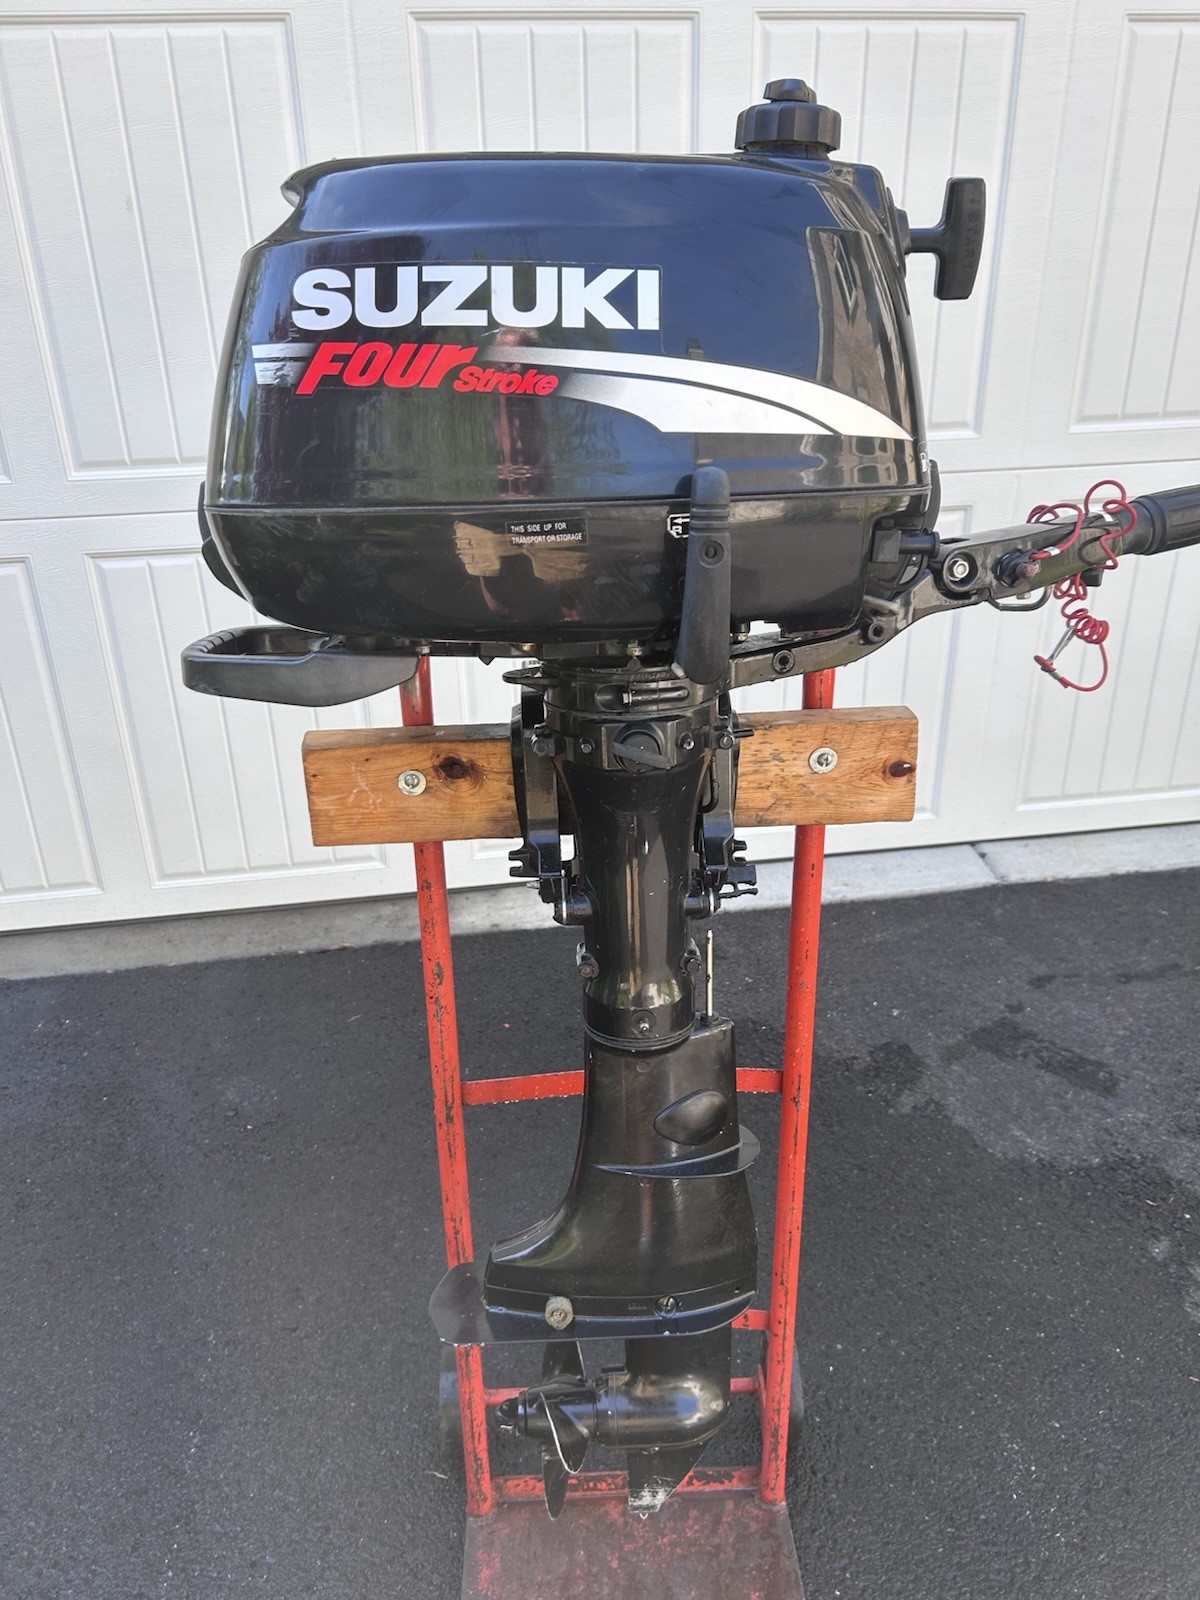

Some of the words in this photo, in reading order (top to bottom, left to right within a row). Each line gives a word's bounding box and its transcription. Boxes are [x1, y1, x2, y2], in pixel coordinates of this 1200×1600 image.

[291, 265, 660, 331] SUZUKI
[453, 366, 559, 397] Stroke
[511, 525, 525, 533] THIS
[527, 524, 541, 532] SIDE
[544, 523, 552, 531] UP
[554, 522, 567, 530] FOR
[511, 535, 546, 544] TRANSPORT
[556, 533, 582, 542] STORAGE
